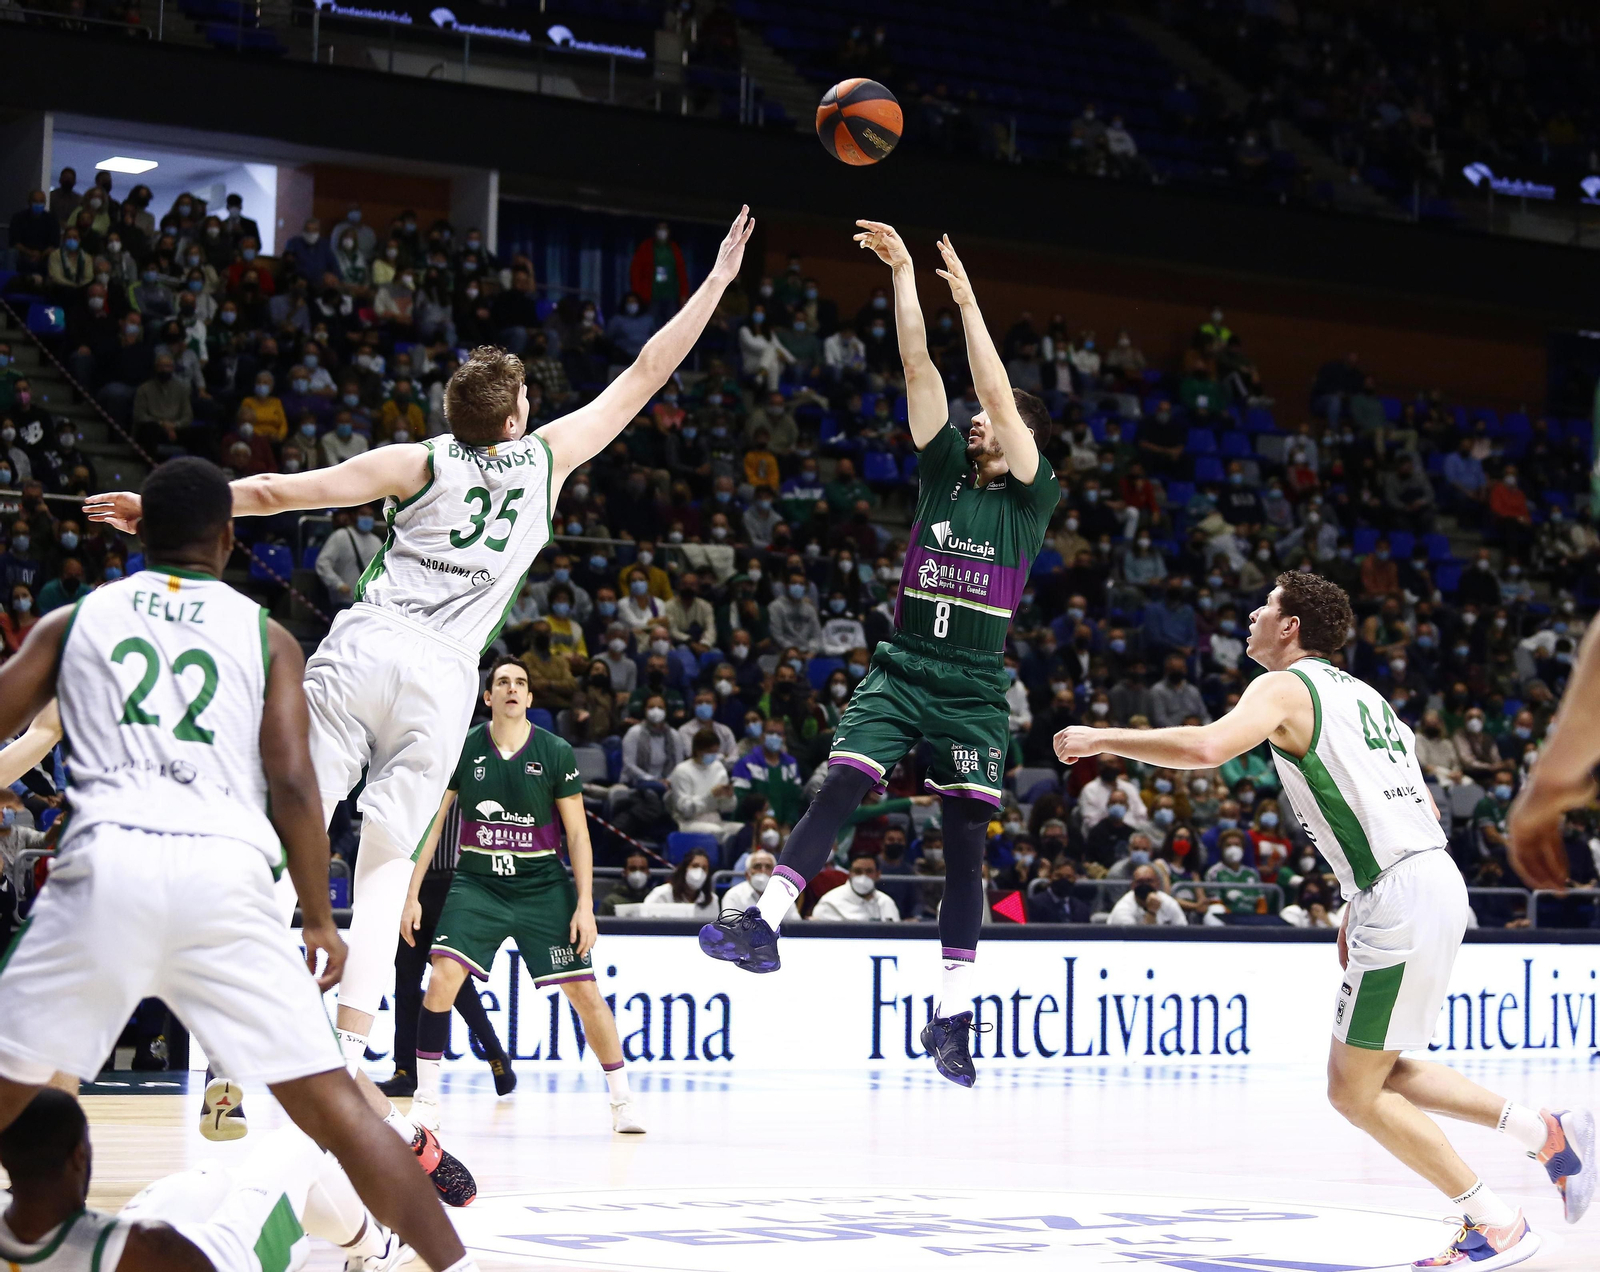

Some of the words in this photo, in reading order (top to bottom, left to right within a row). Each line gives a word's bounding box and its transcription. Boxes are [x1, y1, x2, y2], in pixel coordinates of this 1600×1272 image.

[450, 486, 525, 552] 35
[948, 536, 995, 557] Unicaja
[940, 564, 989, 586] MÁLAGA
[134, 590, 205, 624] FELIZ
[933, 602, 950, 638] 8
[111, 636, 219, 745] 22
[1357, 699, 1410, 768] 44
[501, 812, 535, 825] Unicaja
[491, 854, 516, 876] 43
[868, 955, 1251, 1059] FunteLiviana
[524, 1194, 974, 1213] AUTOPISTA
[744, 1210, 952, 1224] LAS
[497, 1208, 1319, 1250] PEDRIZAS
